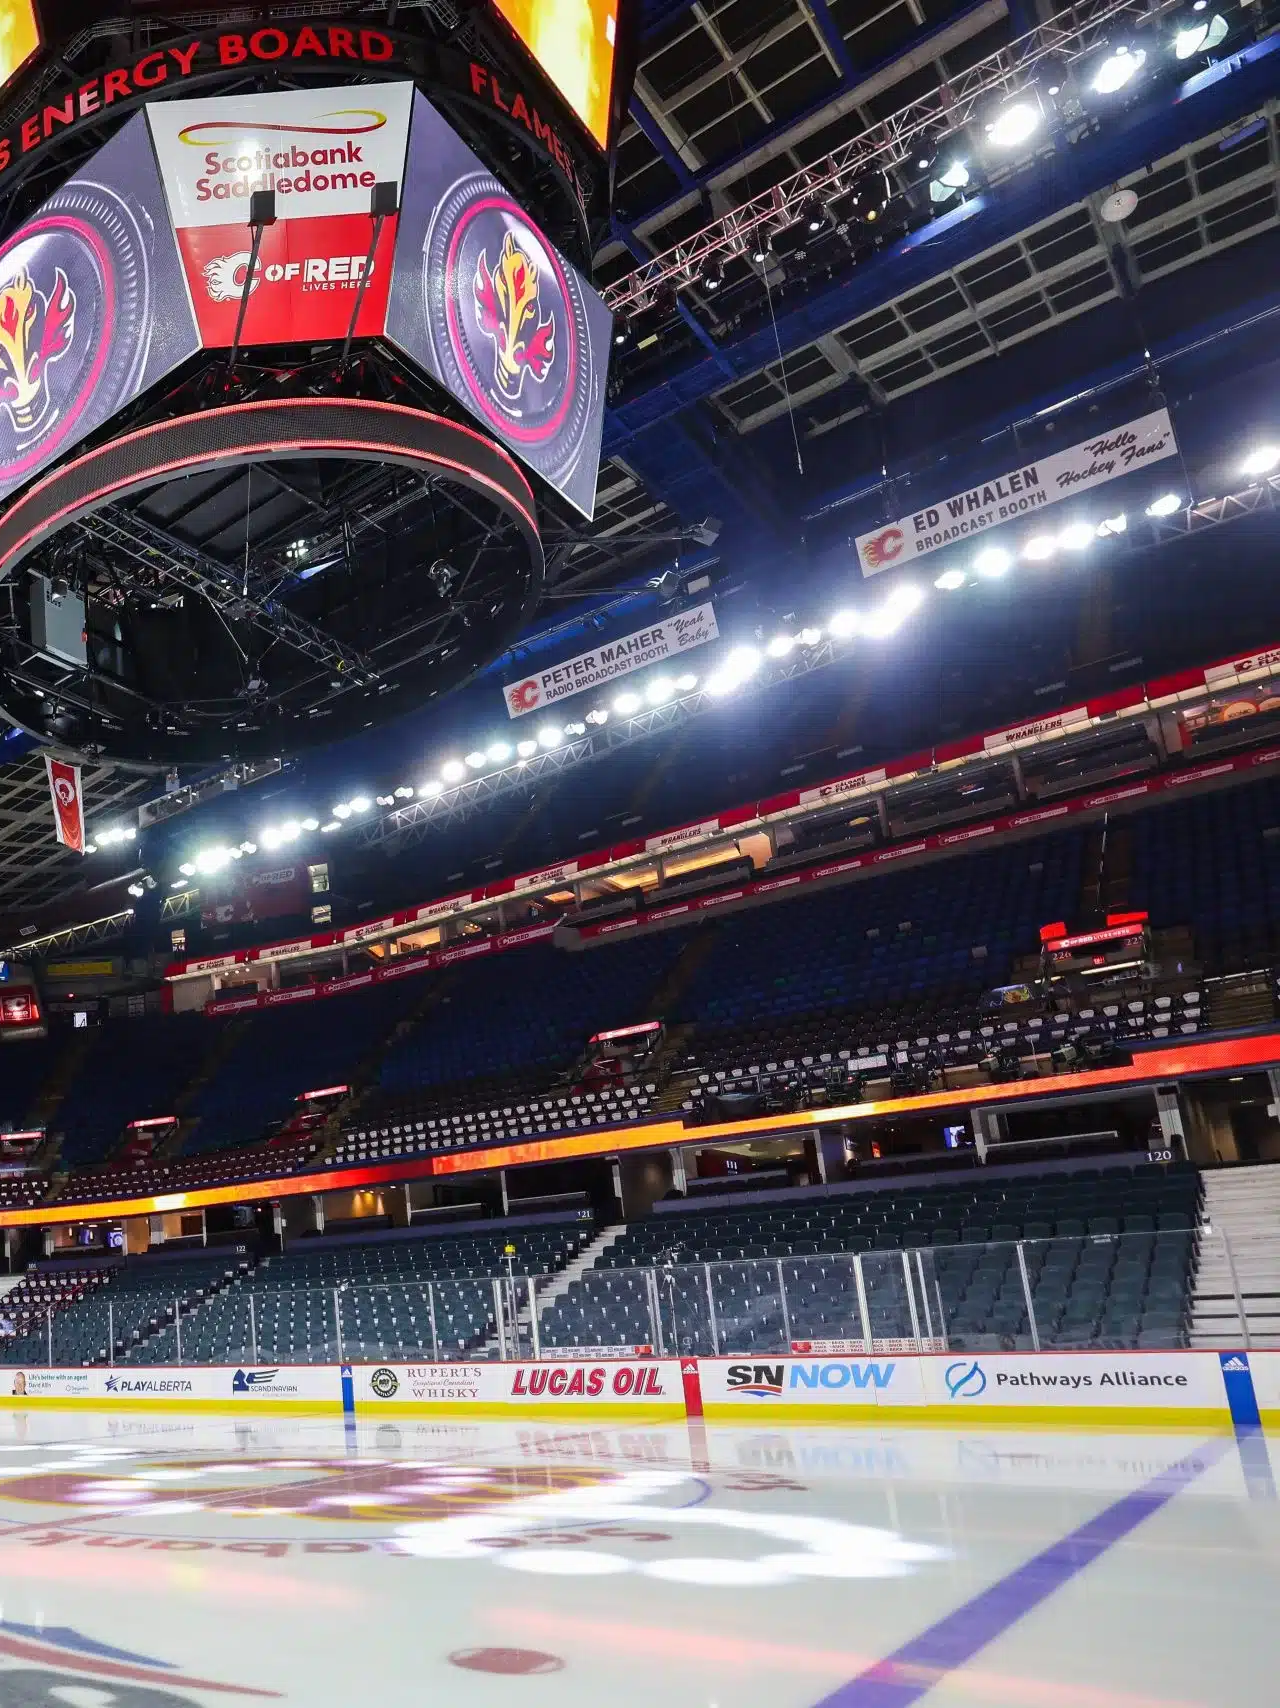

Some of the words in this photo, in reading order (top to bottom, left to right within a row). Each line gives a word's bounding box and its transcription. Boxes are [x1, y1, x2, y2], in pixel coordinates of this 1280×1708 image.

[21, 40, 201, 152] ENERGY
[217, 26, 395, 65] BOARD
[470, 63, 573, 183] FLAMES
[205, 140, 363, 176] Scotiabank
[196, 169, 376, 201] Saddledome
[264, 263, 301, 282] OF
[302, 256, 375, 283] RED
[302, 281, 335, 292] LIVES
[1055, 458, 1117, 489] Hockey
[912, 512, 940, 534] ED
[945, 466, 1040, 519] WHALEN
[915, 514, 994, 552] BROADCAST
[998, 489, 1047, 516] BOOTH
[541, 656, 597, 689] PETER
[600, 627, 666, 666] MAHER
[545, 683, 574, 700] RADIO
[575, 657, 632, 692] BROADCAST
[634, 643, 669, 664] BOOTH
[1005, 719, 1062, 742] WRANGLERS
[835, 781, 867, 793] FLAMES
[660, 828, 701, 846] WRANGLERS
[1147, 1150, 1172, 1162] 120
[407, 1367, 482, 1378] RUPERT'S
[511, 1367, 606, 1396] LUCAS
[612, 1367, 663, 1396] OIL
[726, 1364, 785, 1386] SN
[790, 1363, 896, 1388] NOW
[996, 1371, 1093, 1389] Pathways
[1100, 1372, 1188, 1387] Alliance
[121, 1380, 192, 1392] PLAYALBERTA
[250, 1385, 298, 1393] SCANDINAVIAN
[412, 1388, 480, 1398] WHISKY
